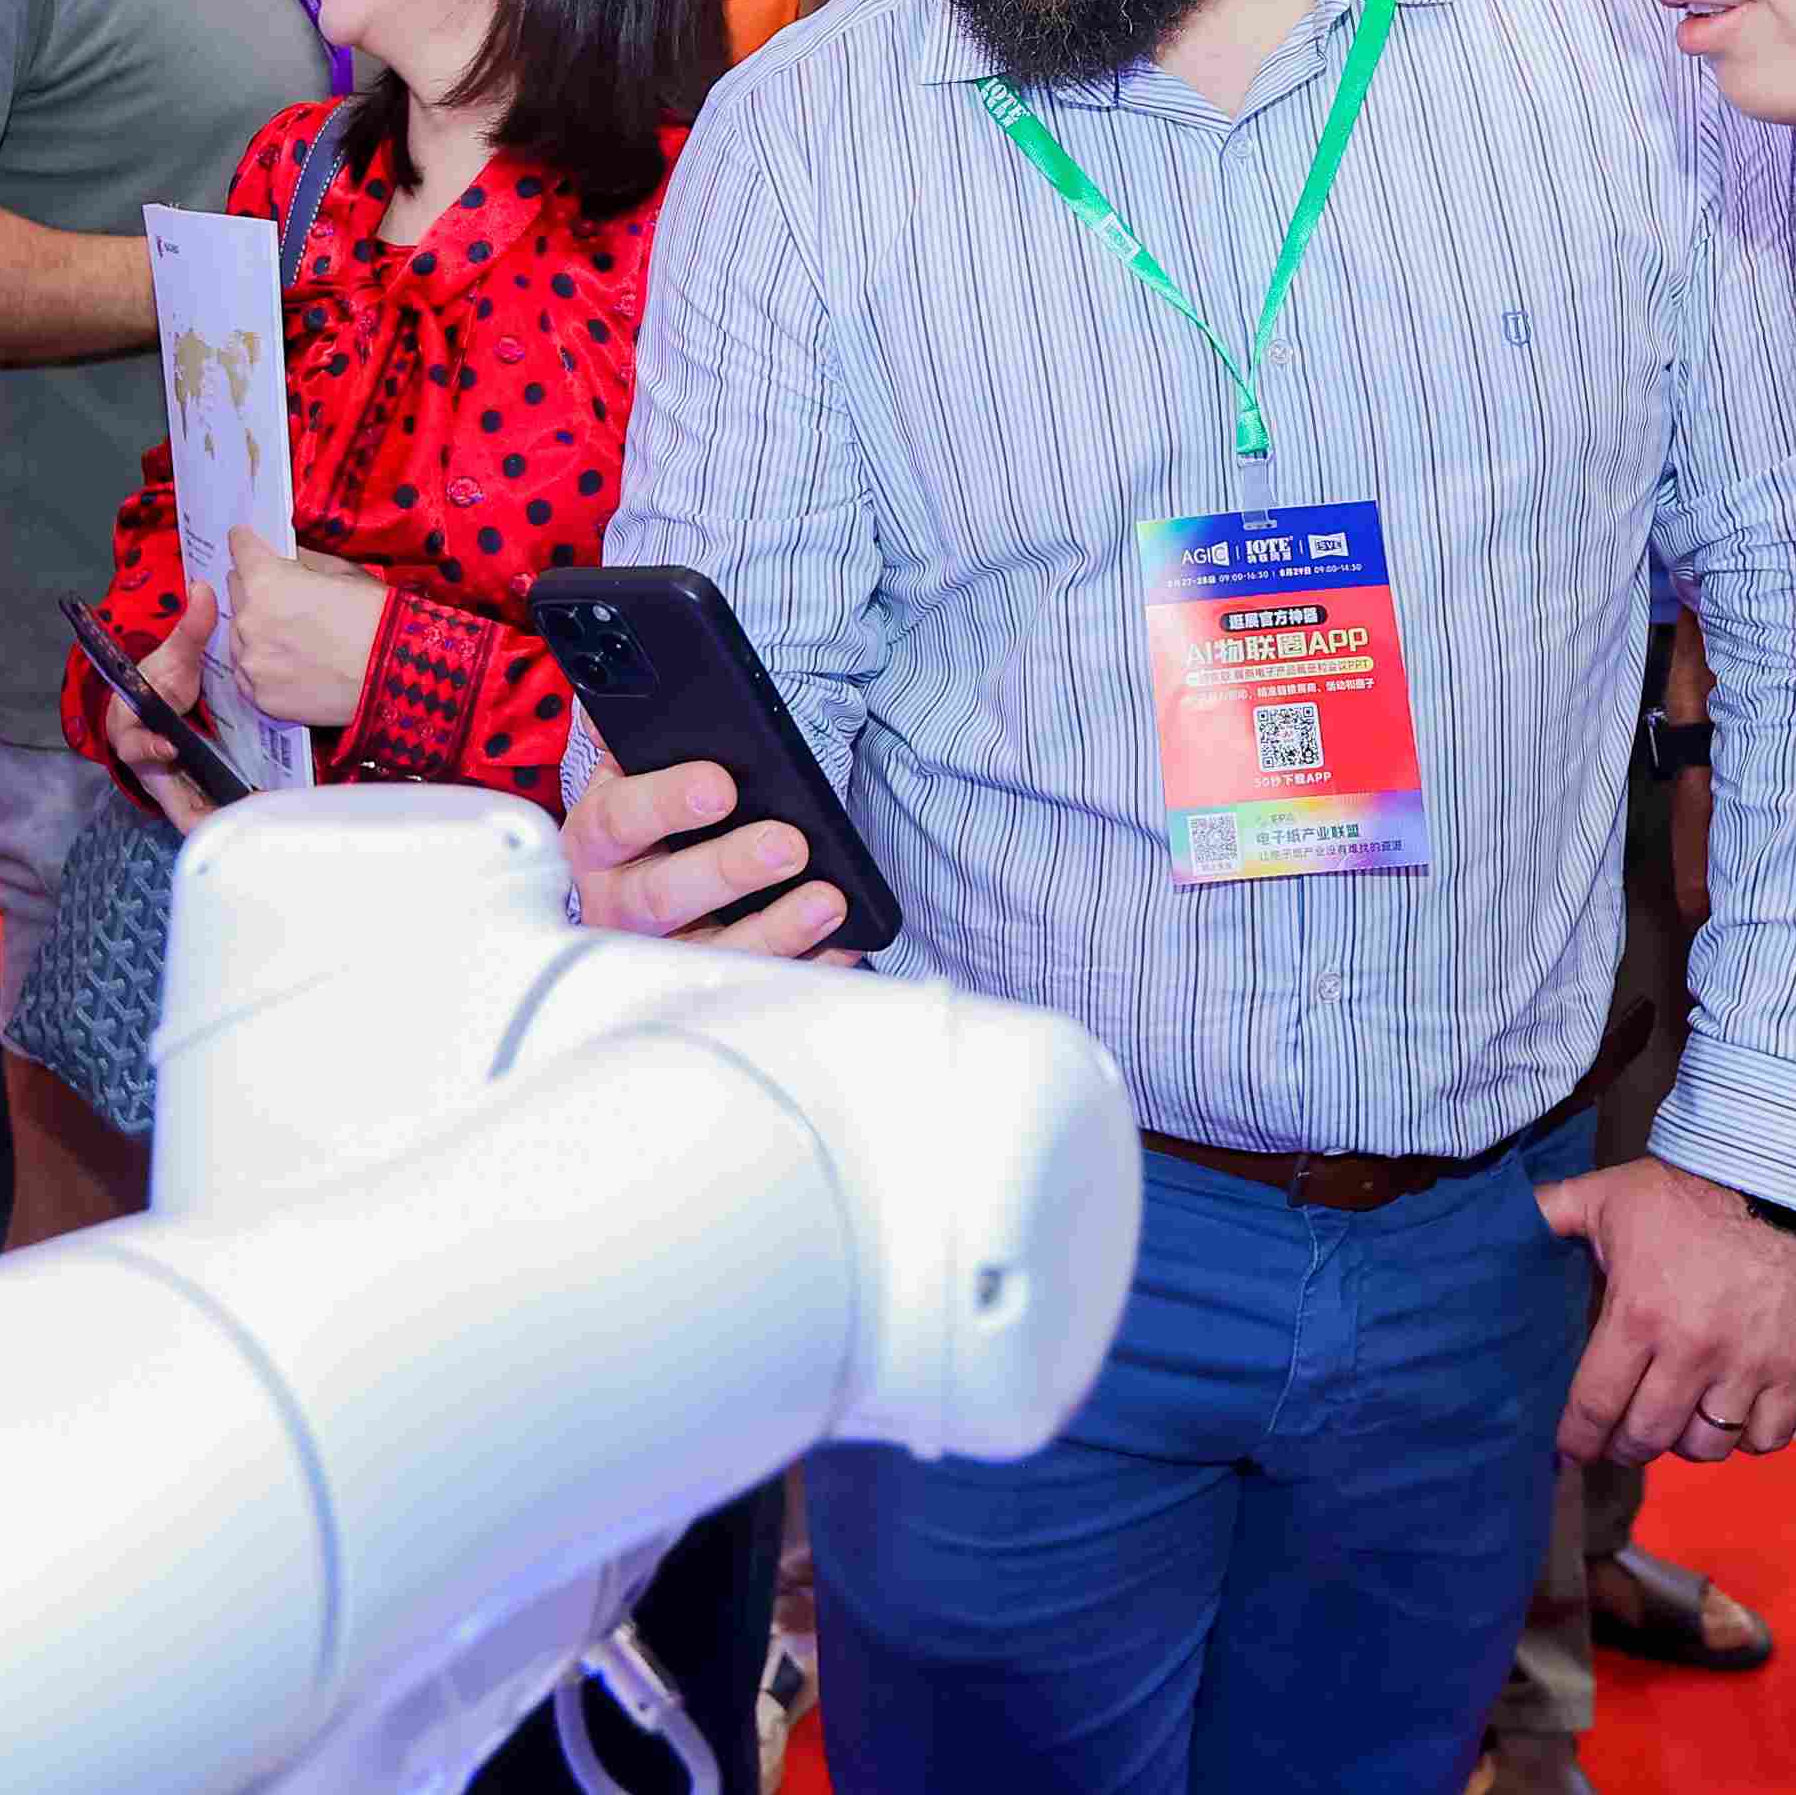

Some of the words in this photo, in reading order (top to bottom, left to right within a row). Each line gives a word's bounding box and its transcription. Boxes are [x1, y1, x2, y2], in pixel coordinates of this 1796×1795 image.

[1182, 541, 1229, 566] AGIC
[1245, 537, 1292, 555] IOTE
[1228, 607, 1318, 631] 逛展官方神器
[1256, 823, 1360, 846] 电子纸产业联盟
